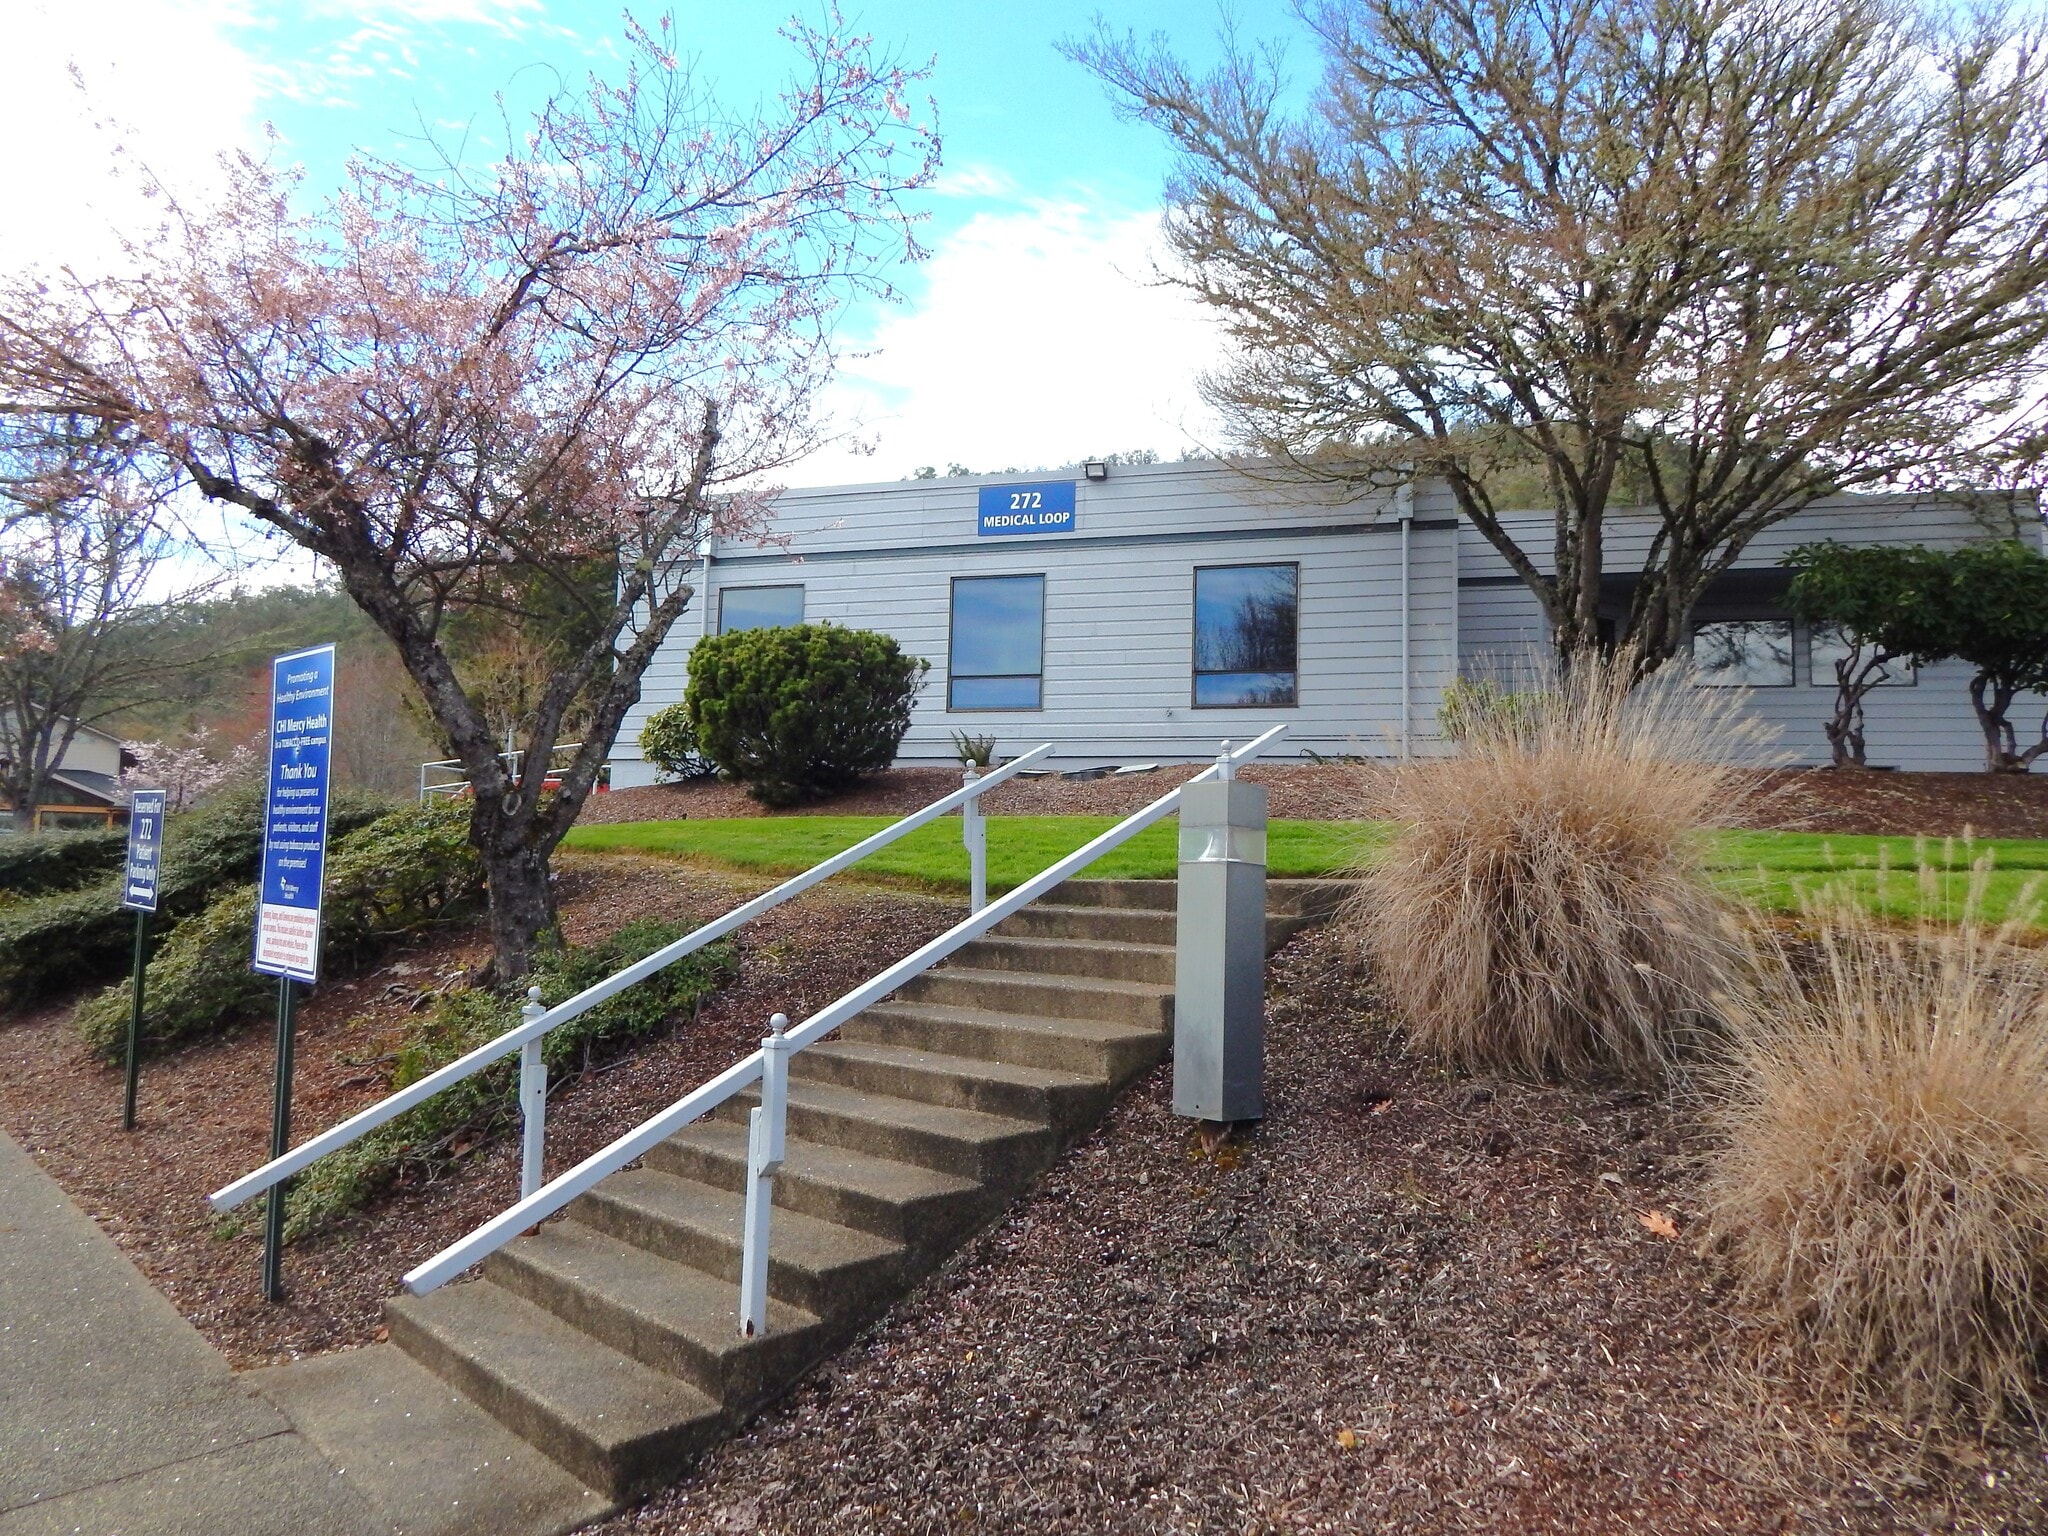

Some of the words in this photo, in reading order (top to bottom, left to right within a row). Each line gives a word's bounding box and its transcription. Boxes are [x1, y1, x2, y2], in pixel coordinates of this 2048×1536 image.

[1010, 492, 1042, 510] 272
[983, 514, 1036, 528] MEDICAL
[1039, 512, 1070, 525] LOOP
[287, 670, 314, 684] Promoting
[314, 671, 319, 680] a
[276, 691, 296, 704] Healthy
[295, 686, 329, 701] Environment
[276, 719, 287, 733] CHI
[287, 718, 306, 734] Mercy
[306, 713, 327, 730] Health
[282, 736, 311, 748] TOBACCO-FREE
[310, 736, 327, 746] campus
[280, 762, 303, 780] Thank
[303, 762, 318, 778] You
[282, 786, 296, 799] helping
[134, 798, 154, 813] Reserved
[154, 798, 162, 813] For
[285, 804, 308, 815] environment
[140, 818, 153, 840] 272
[136, 844, 153, 860] Patient
[130, 862, 146, 884] Parking
[146, 864, 156, 885] Only
